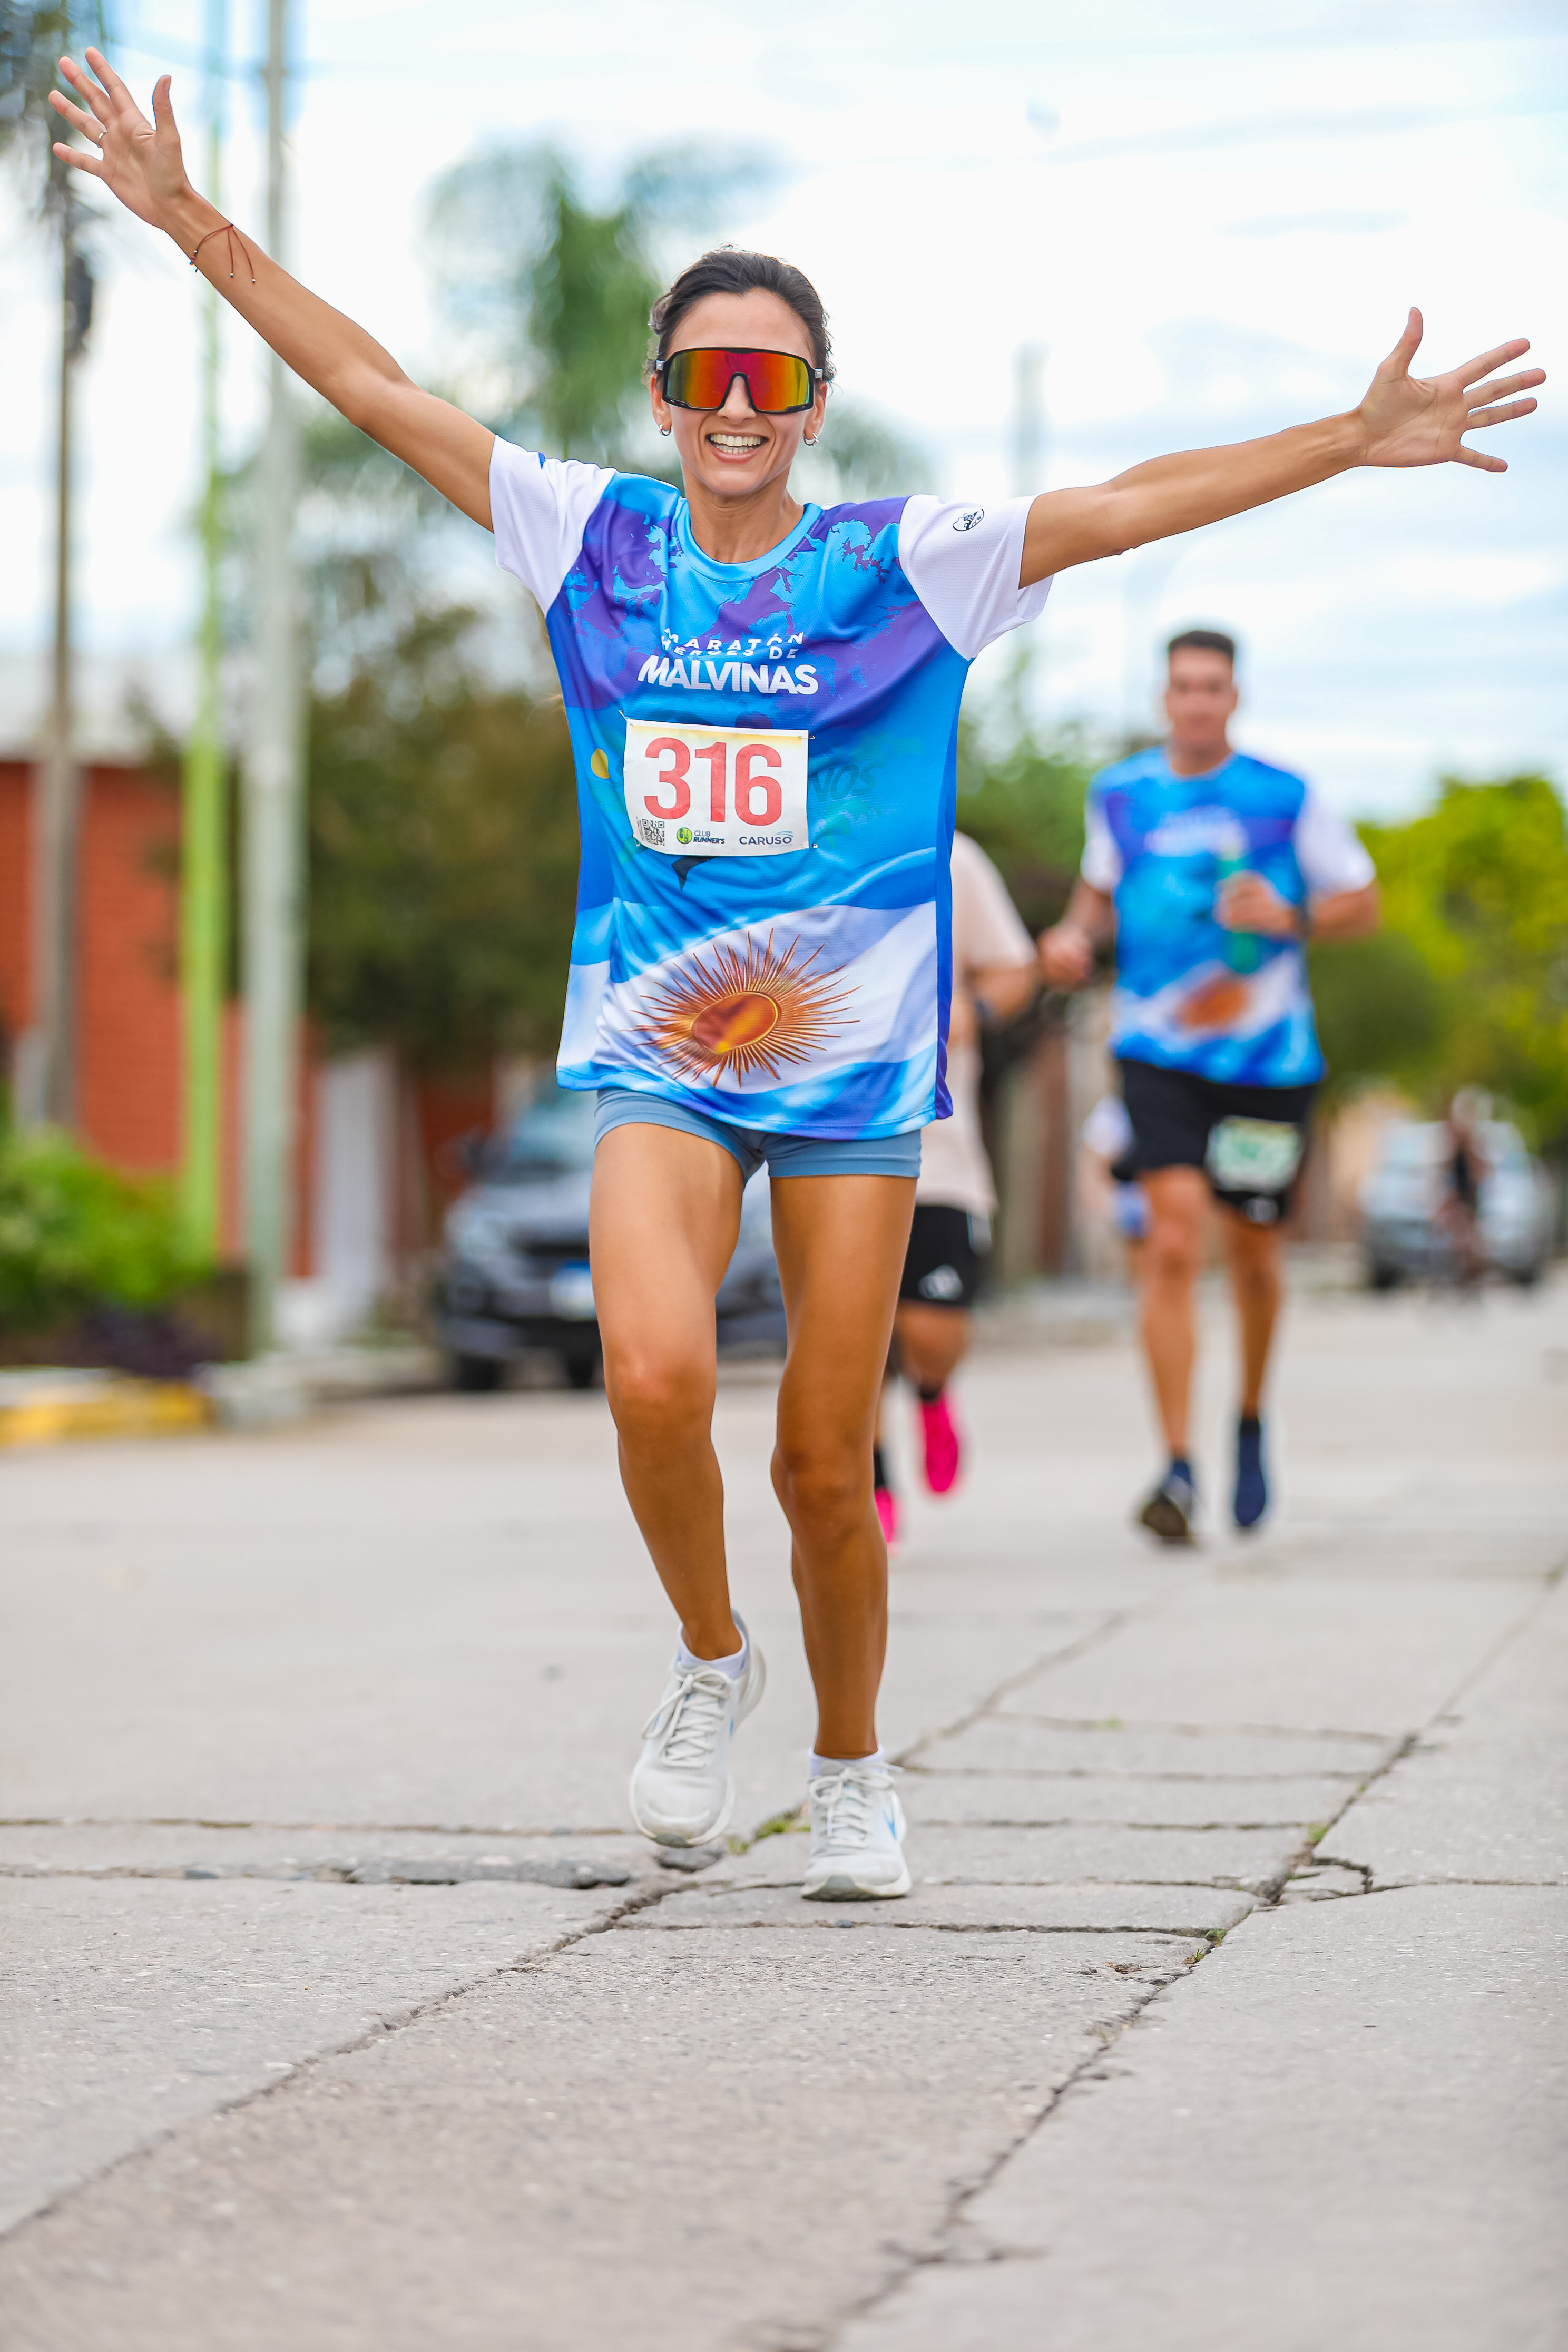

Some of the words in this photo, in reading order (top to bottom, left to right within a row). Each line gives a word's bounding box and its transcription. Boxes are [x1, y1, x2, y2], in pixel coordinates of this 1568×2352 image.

[769, 646, 798, 660] DE
[637, 655, 819, 695] MALVINAS
[644, 737, 782, 826] 316
[739, 836, 792, 845] CARUSO
